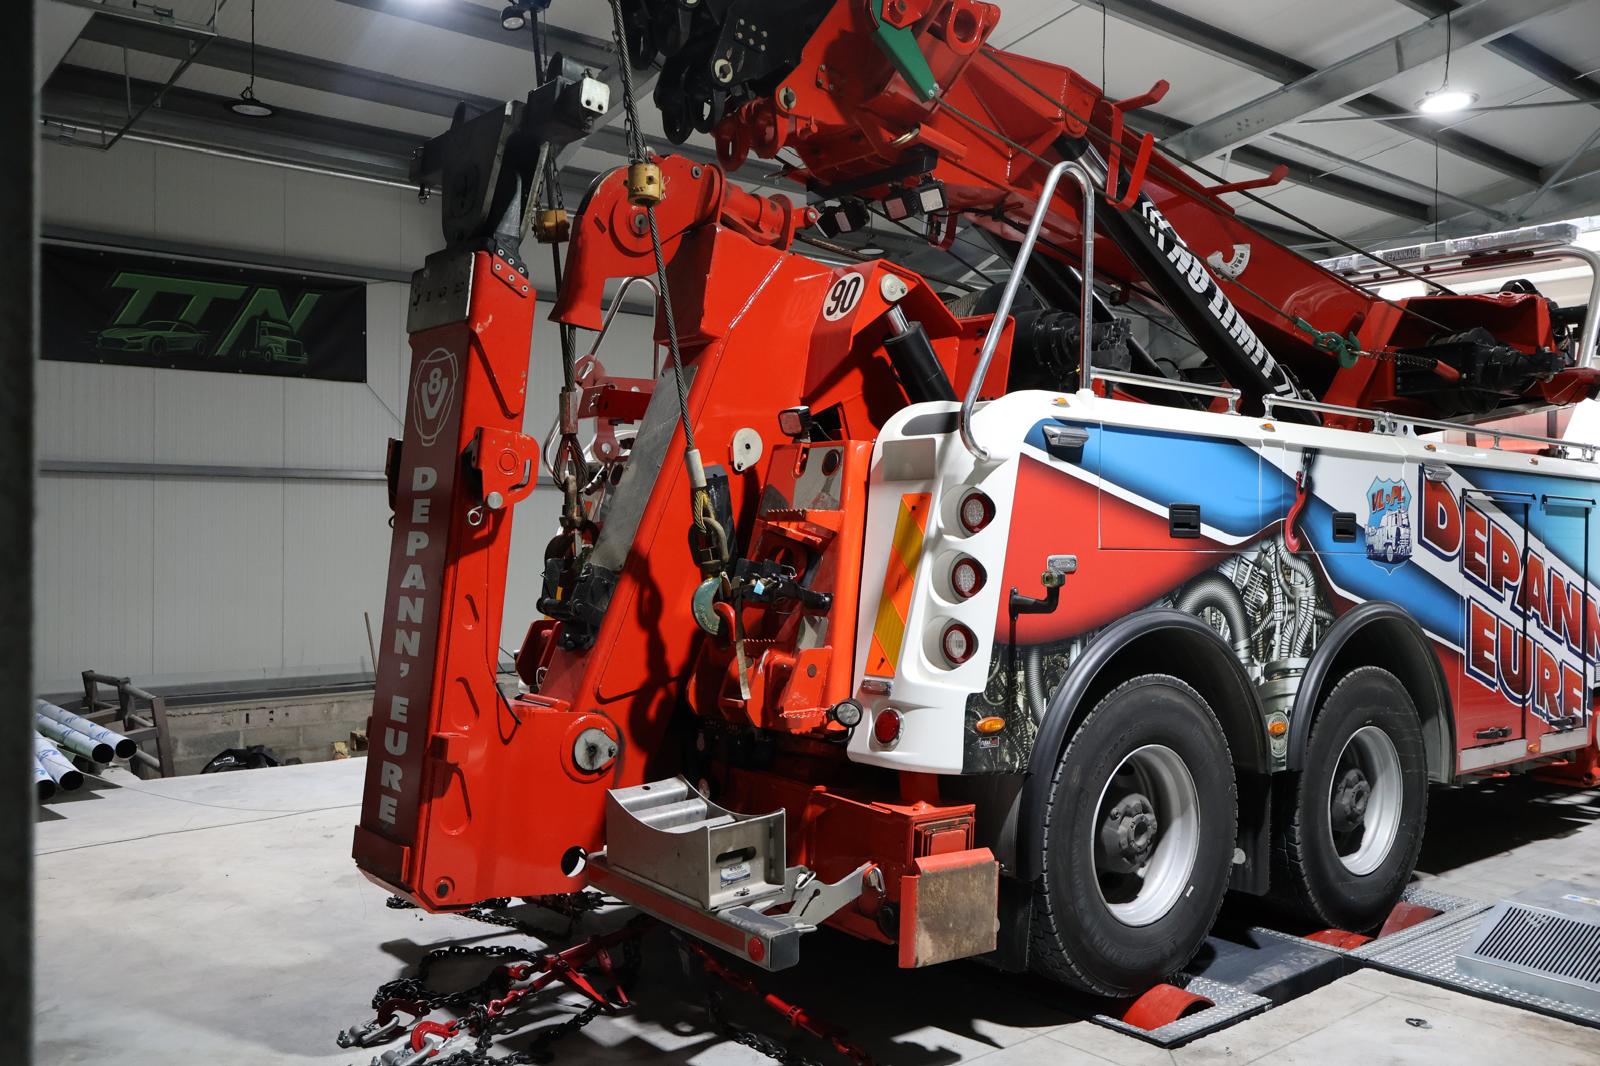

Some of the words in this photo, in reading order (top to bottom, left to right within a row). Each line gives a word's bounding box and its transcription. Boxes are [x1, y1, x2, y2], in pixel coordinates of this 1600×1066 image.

[1382, 248, 1421, 262] DEPANNAGE
[826, 276, 861, 317] 90
[1207, 284, 1276, 379] LIMIT
[1464, 597, 1587, 730] EURE
